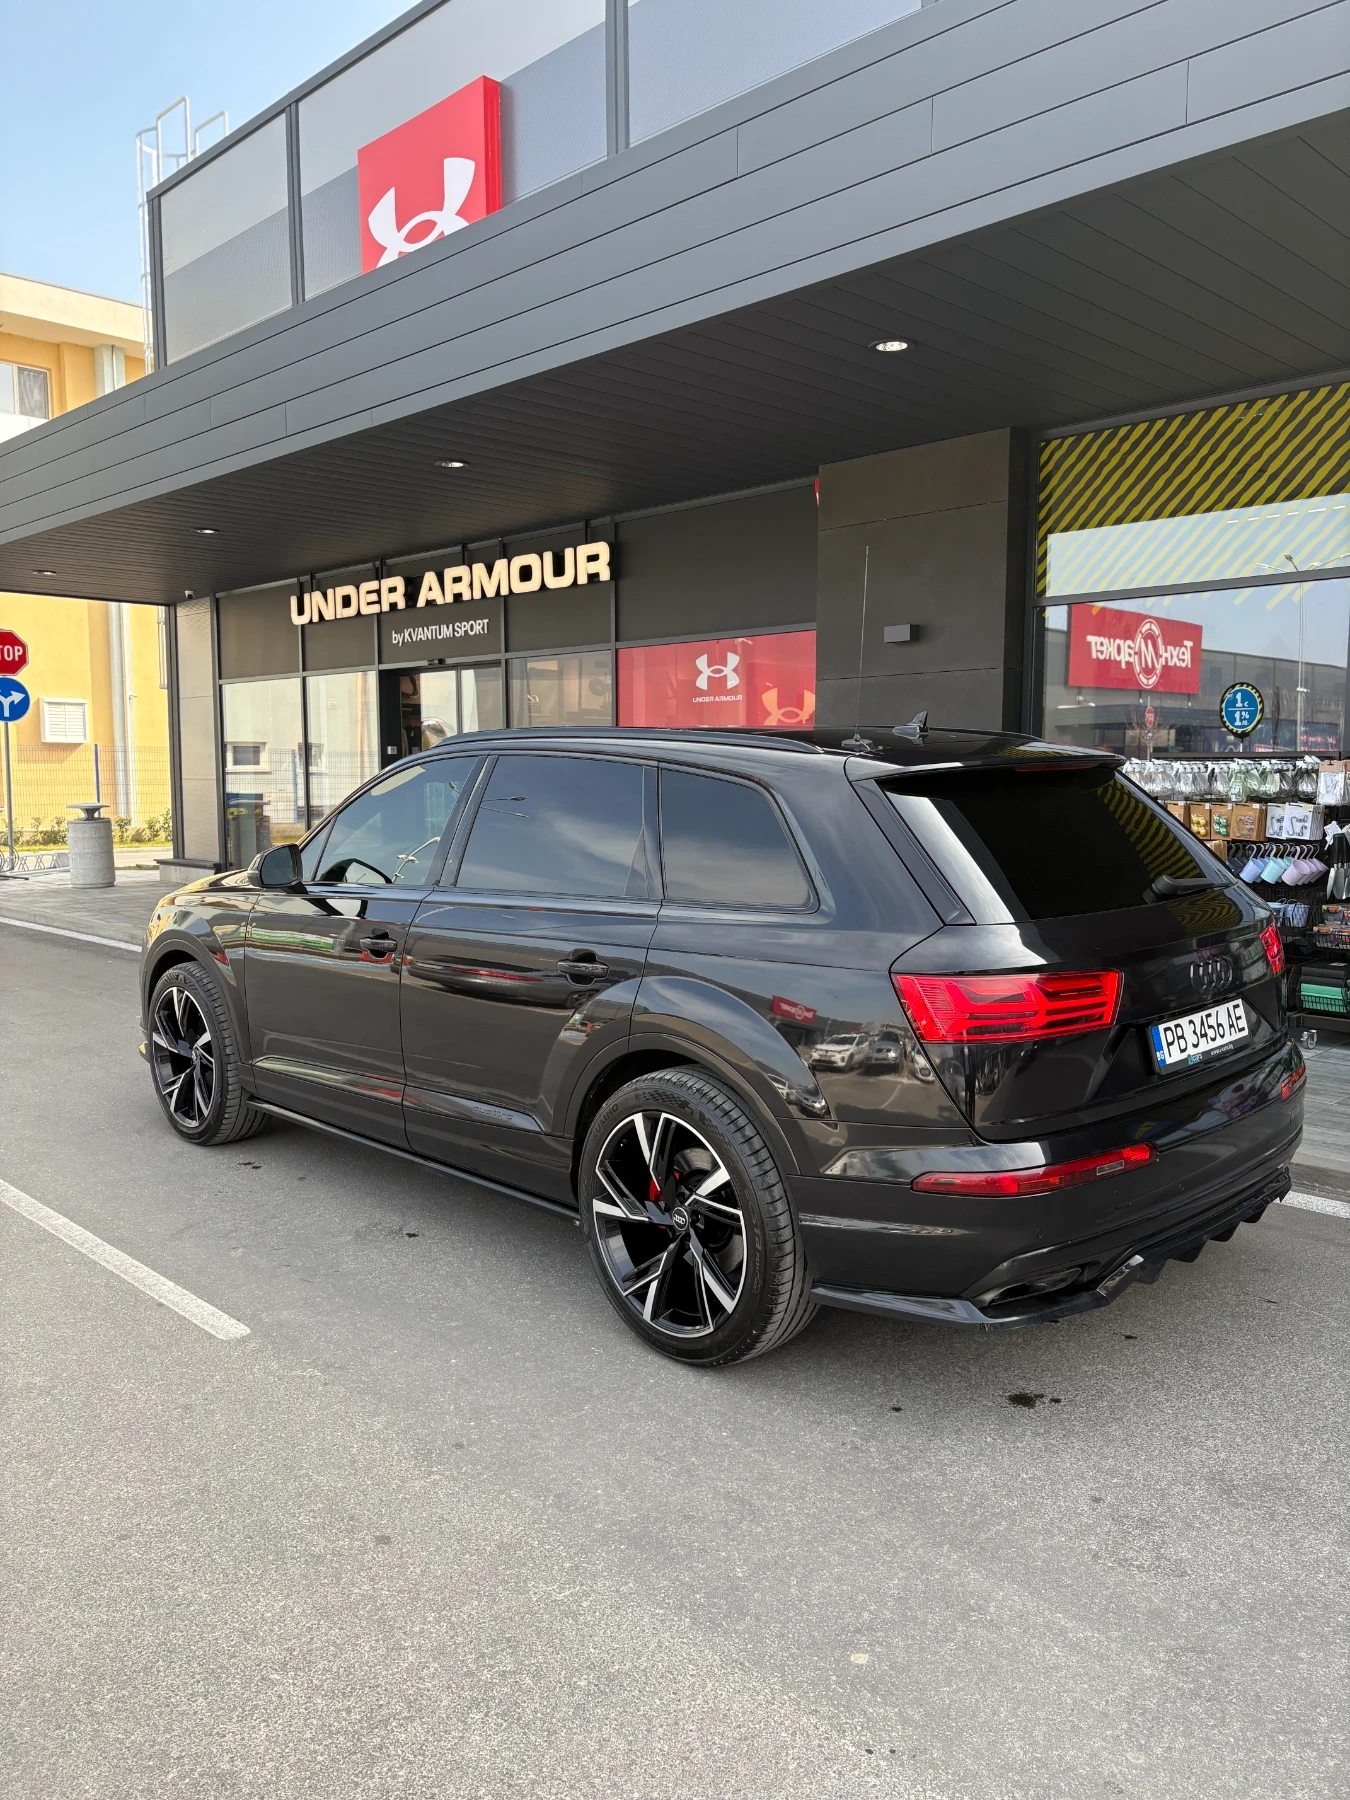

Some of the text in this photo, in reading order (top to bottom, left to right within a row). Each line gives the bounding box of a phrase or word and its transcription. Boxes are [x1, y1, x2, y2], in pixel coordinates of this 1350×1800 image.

[290, 541, 611, 626] UNDER ARMOUR
[392, 618, 490, 647] by KVANTUM SPORT
[692, 694, 743, 703] UNDER ARMOUR
[1163, 1003, 1246, 1058] PB 3456 AE
